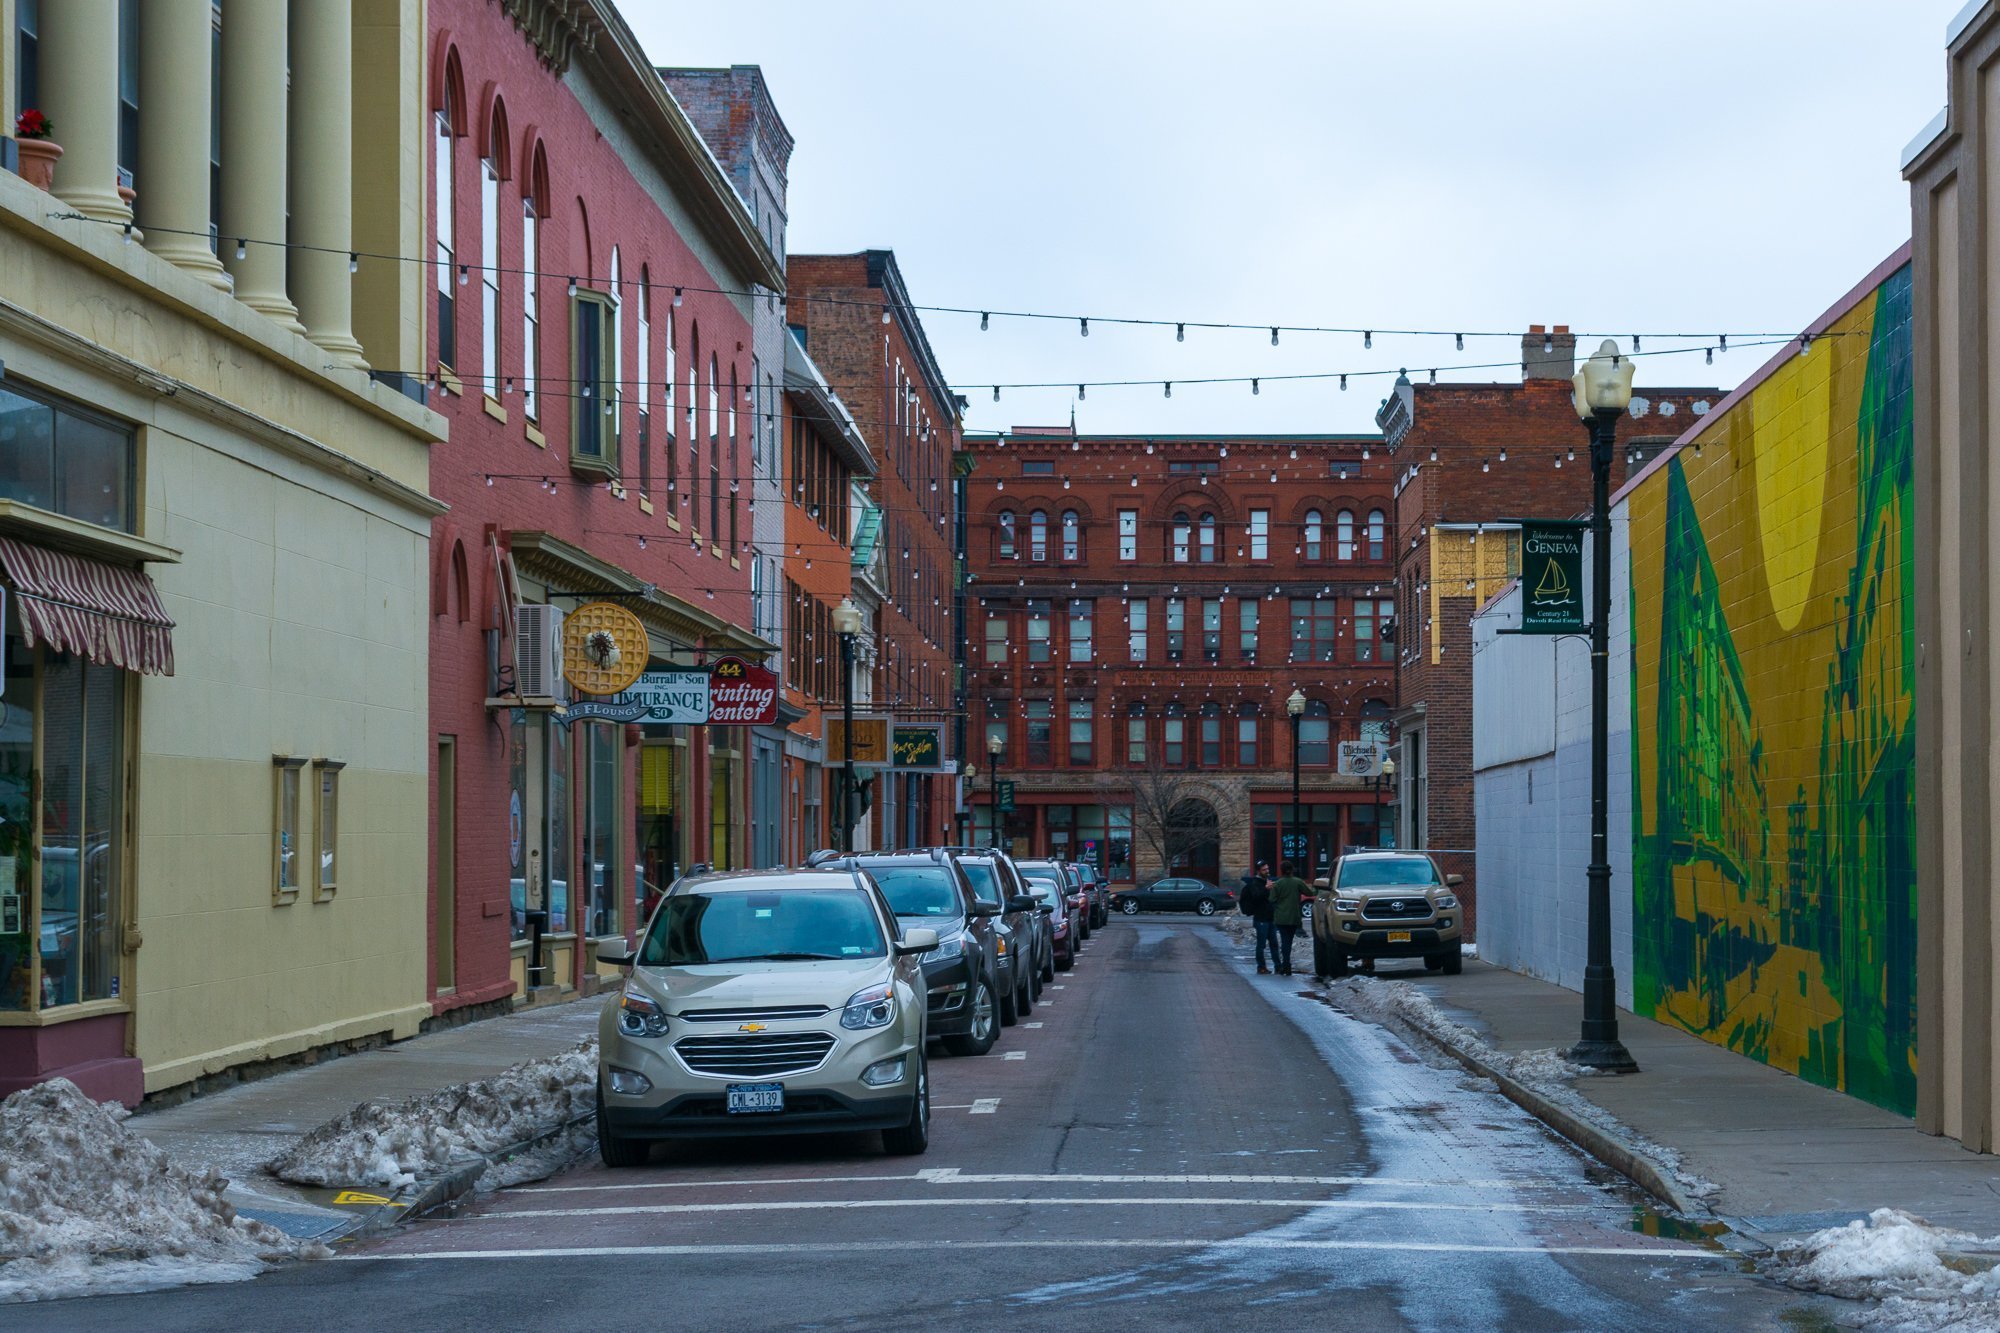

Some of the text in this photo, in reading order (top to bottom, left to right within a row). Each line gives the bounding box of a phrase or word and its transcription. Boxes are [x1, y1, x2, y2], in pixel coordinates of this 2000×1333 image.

[1526, 539, 1579, 553] GENEVA
[719, 664, 741, 677] 44
[641, 673, 677, 684] Burrall
[685, 673, 705, 684] Son
[710, 682, 774, 707] rinting
[654, 708, 668, 718] 50
[710, 701, 766, 720] enter
[755, 1092, 777, 1106] 3139
